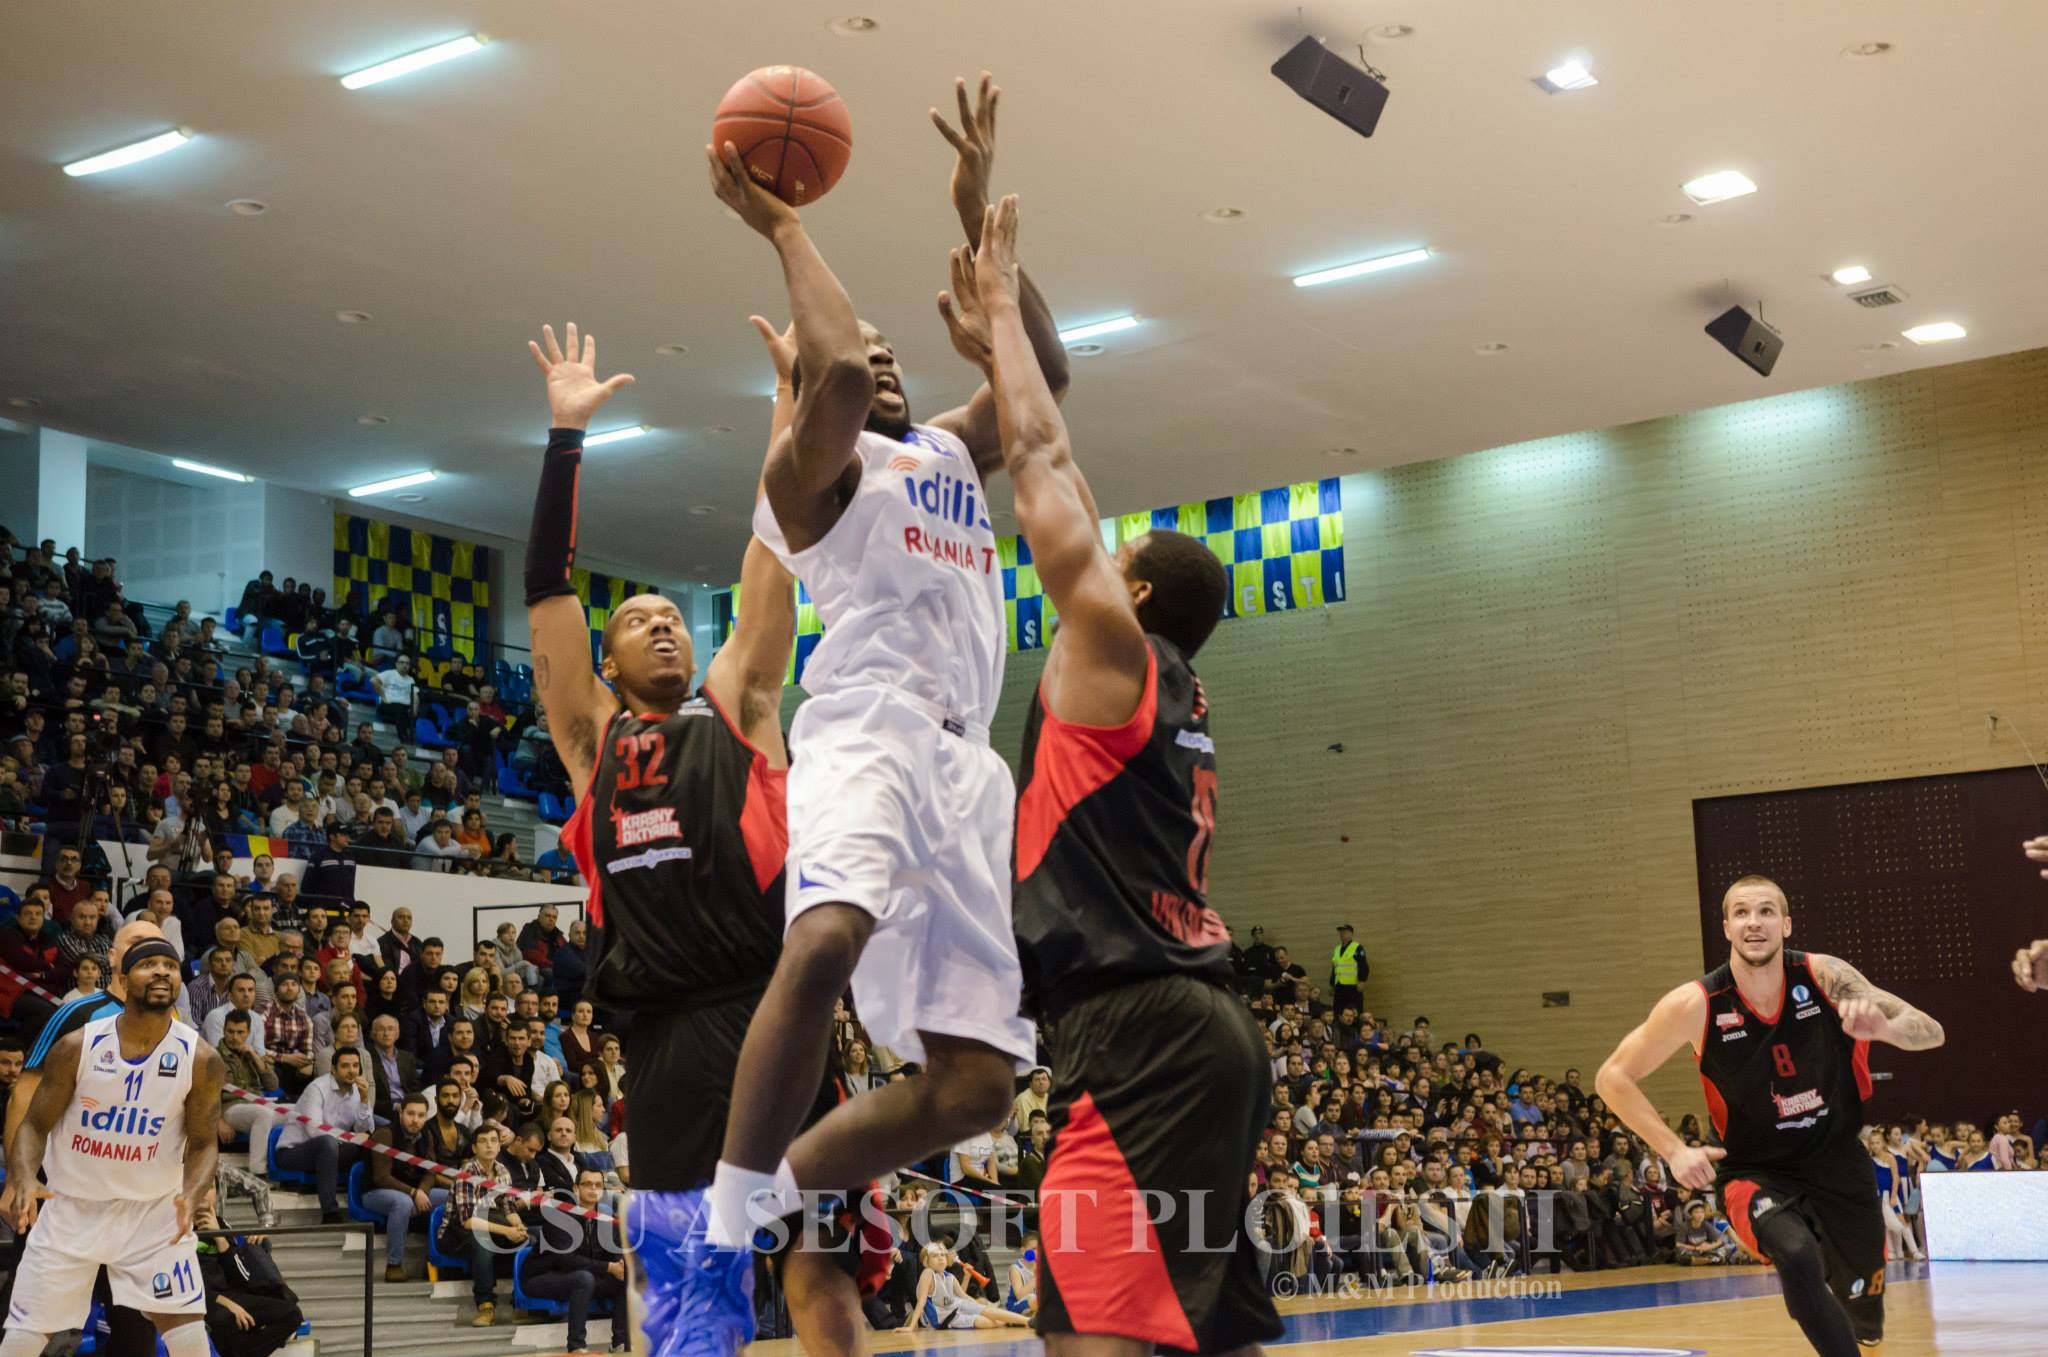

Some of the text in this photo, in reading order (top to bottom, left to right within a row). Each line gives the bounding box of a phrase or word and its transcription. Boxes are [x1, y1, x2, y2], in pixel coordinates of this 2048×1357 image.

[904, 526, 976, 571] RANIA
[615, 732, 668, 790] 32
[1772, 1043, 1797, 1078] 8
[124, 1070, 144, 1102] 11
[80, 1105, 167, 1137] idilis
[71, 1134, 142, 1162] ROMANIA
[173, 1259, 195, 1293] 11
